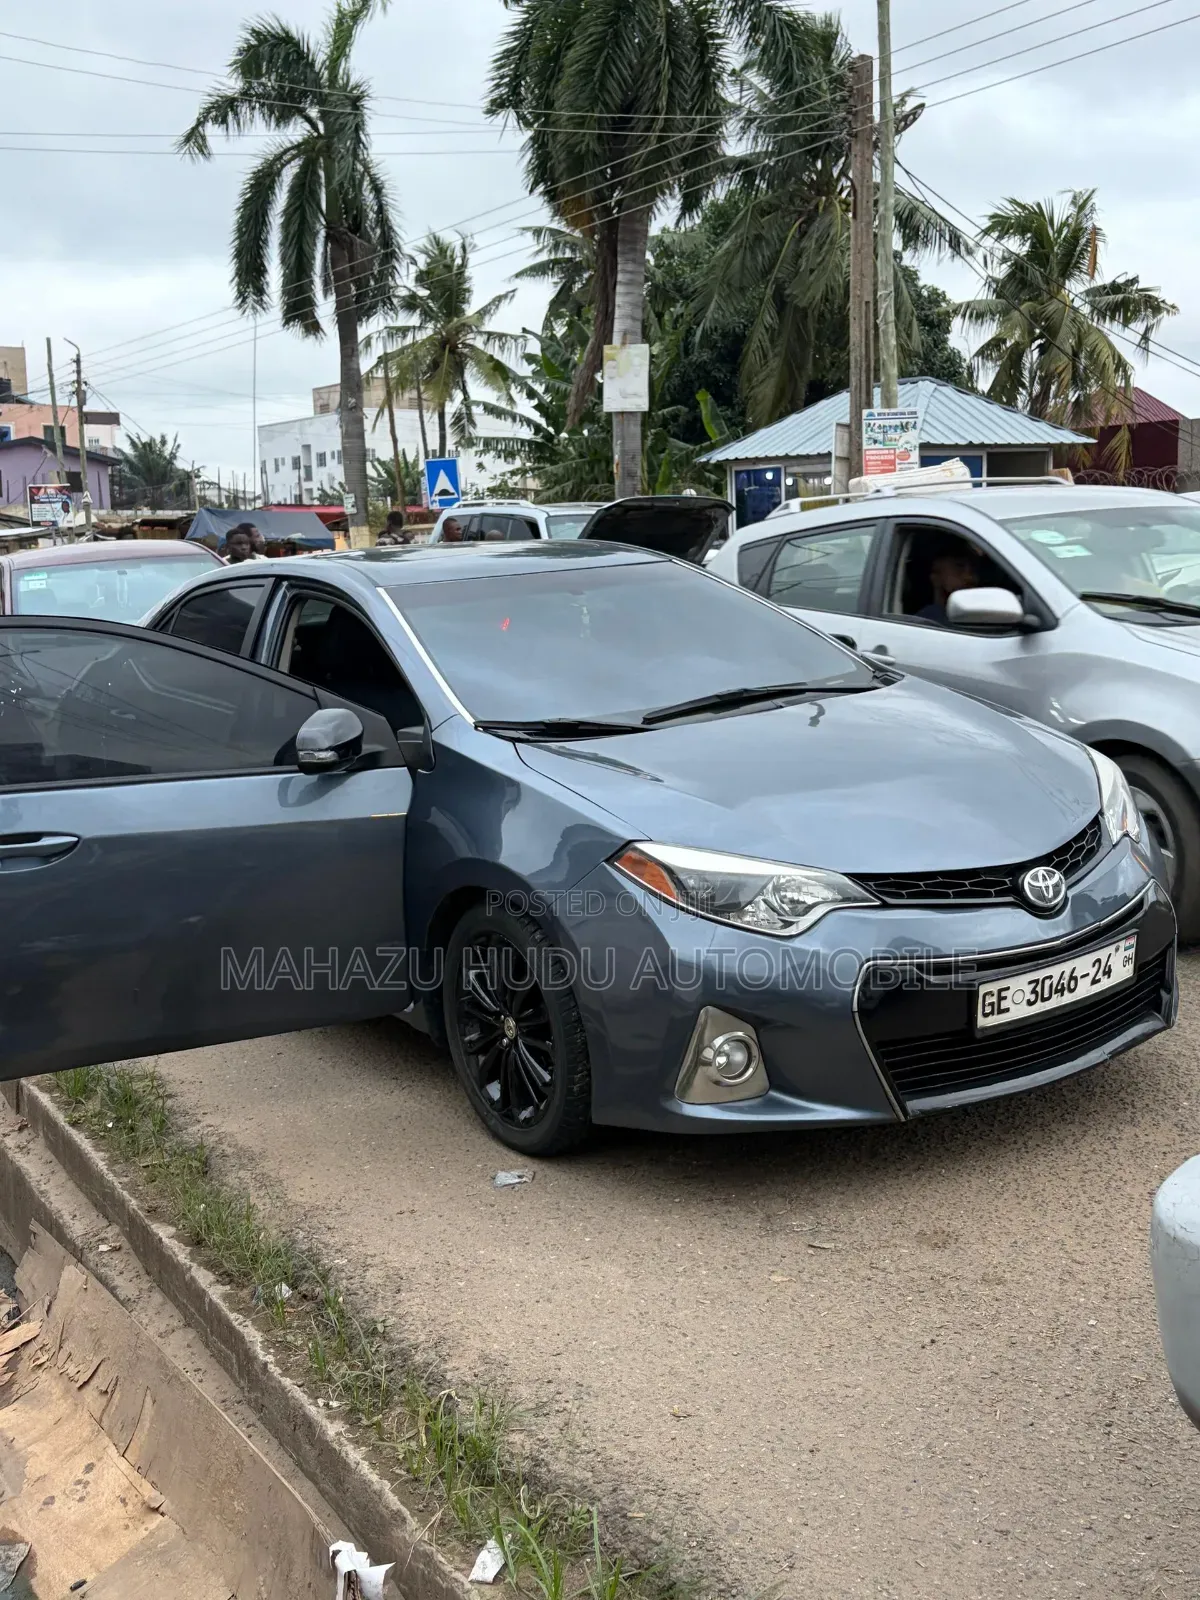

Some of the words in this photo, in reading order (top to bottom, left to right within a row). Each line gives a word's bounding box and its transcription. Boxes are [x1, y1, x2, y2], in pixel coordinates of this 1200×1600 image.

[1122, 952, 1133, 968] GH
[981, 986, 1010, 1018] GE
[1026, 953, 1112, 1007] 3046-24
